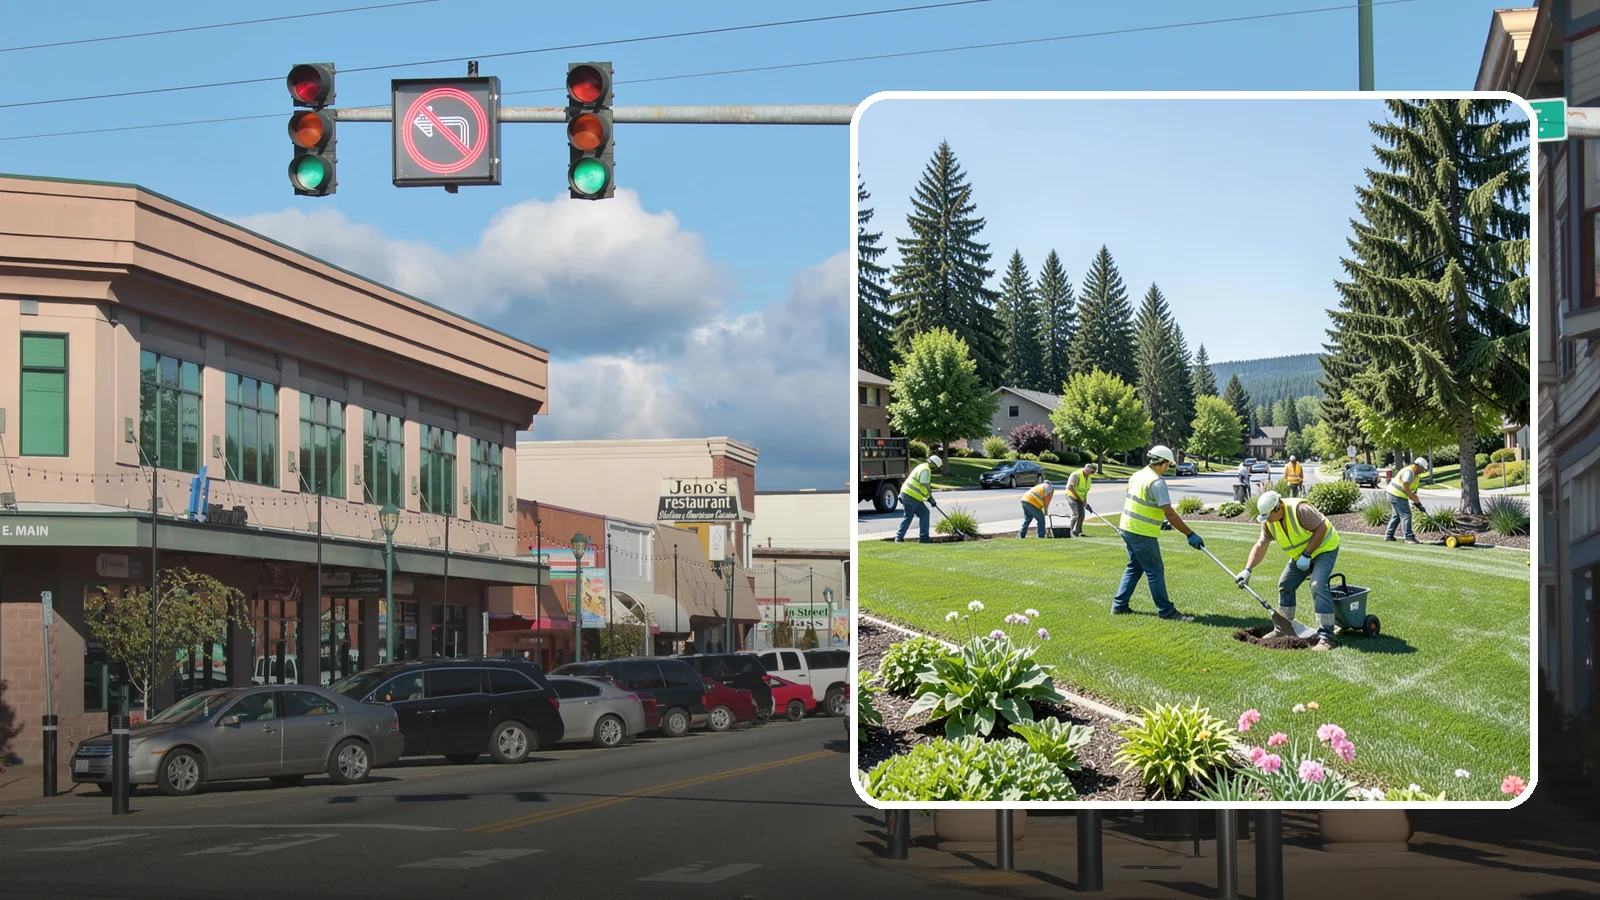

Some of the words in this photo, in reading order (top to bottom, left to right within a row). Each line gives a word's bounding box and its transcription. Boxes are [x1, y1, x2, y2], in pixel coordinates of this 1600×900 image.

[670, 480, 727, 494] Jeno's
[665, 496, 731, 509] restaurant
[686, 510, 714, 519] American
[715, 510, 738, 519] Cuisine
[2, 525, 13, 536] E.
[15, 525, 49, 536] MAIN
[797, 608, 828, 616] Street
